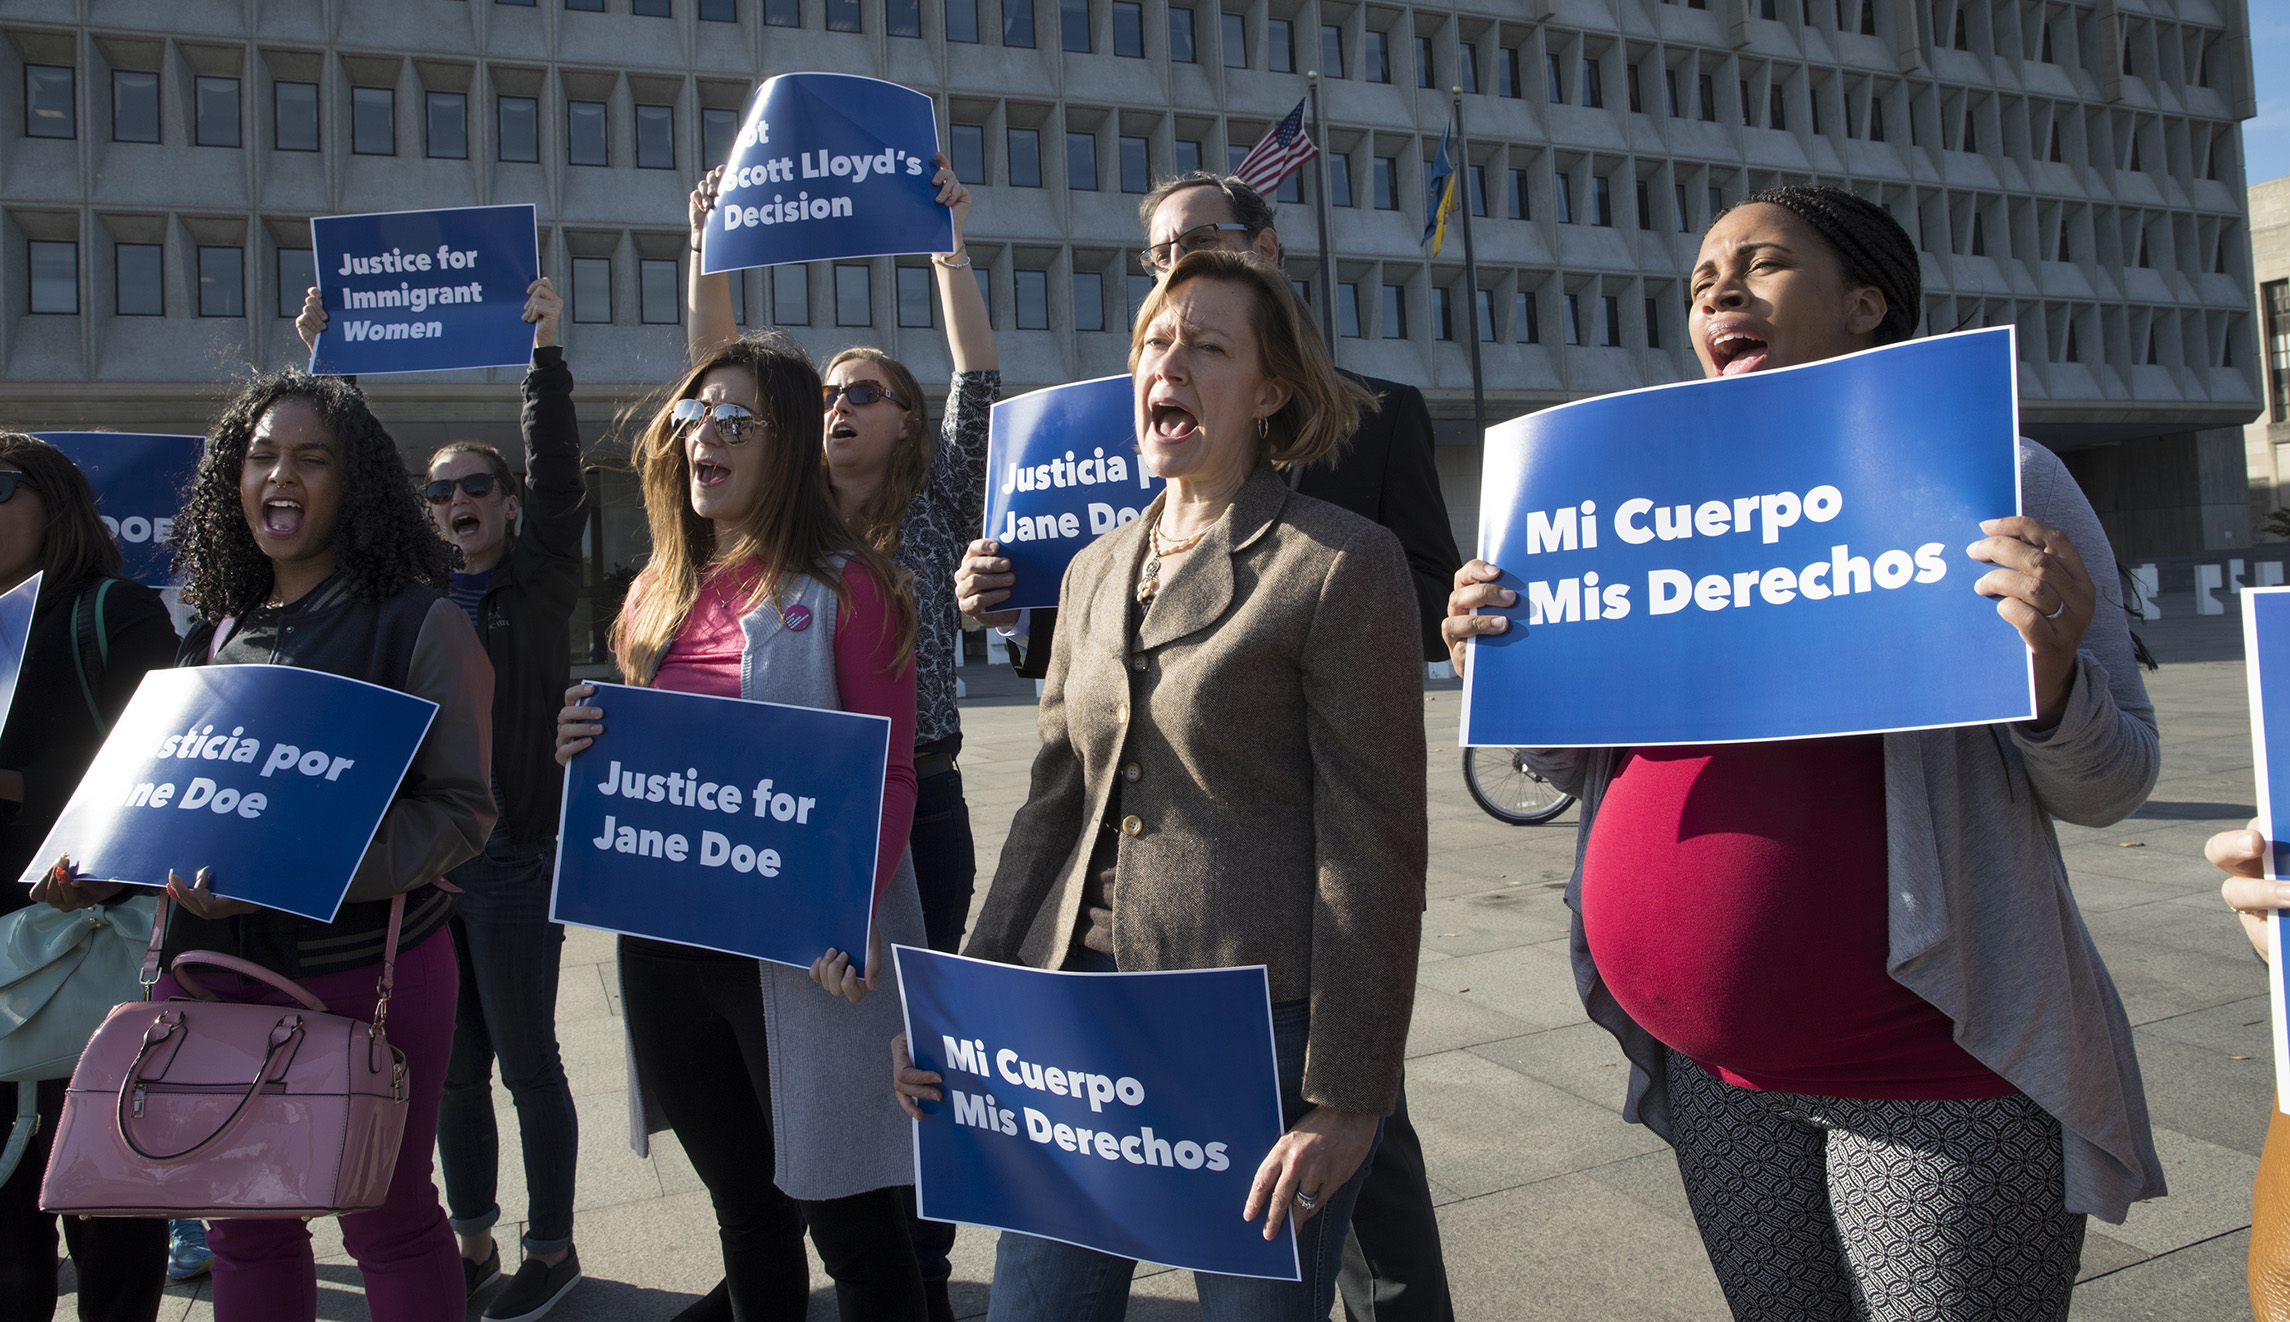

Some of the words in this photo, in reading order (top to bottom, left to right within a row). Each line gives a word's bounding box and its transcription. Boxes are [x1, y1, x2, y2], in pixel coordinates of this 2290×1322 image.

[723, 157, 794, 192] Scott
[801, 148, 923, 183] Lloyd's
[724, 191, 853, 231] Decision
[338, 247, 432, 276] Justice
[436, 244, 478, 270] for
[342, 282, 483, 312] Immigrant
[343, 320, 443, 342] Women
[1002, 446, 1128, 495] Justicia
[999, 511, 1080, 544] Jane
[1088, 502, 1151, 536] Do
[1526, 499, 1598, 555] Mi
[1614, 484, 1843, 545] Cuerpo
[1528, 571, 1632, 625] Mis
[1648, 542, 1948, 616] Derechos
[259, 742, 355, 782] por
[177, 776, 268, 819] Doe
[597, 760, 743, 814] Justice
[752, 778, 817, 825] for
[592, 815, 689, 862] Jane
[700, 829, 782, 878] Doe
[942, 1034, 991, 1078] Mi
[996, 1048, 1145, 1113] Cuerpo
[951, 1089, 1018, 1136] Mis
[1023, 1106, 1231, 1172] Derechos
